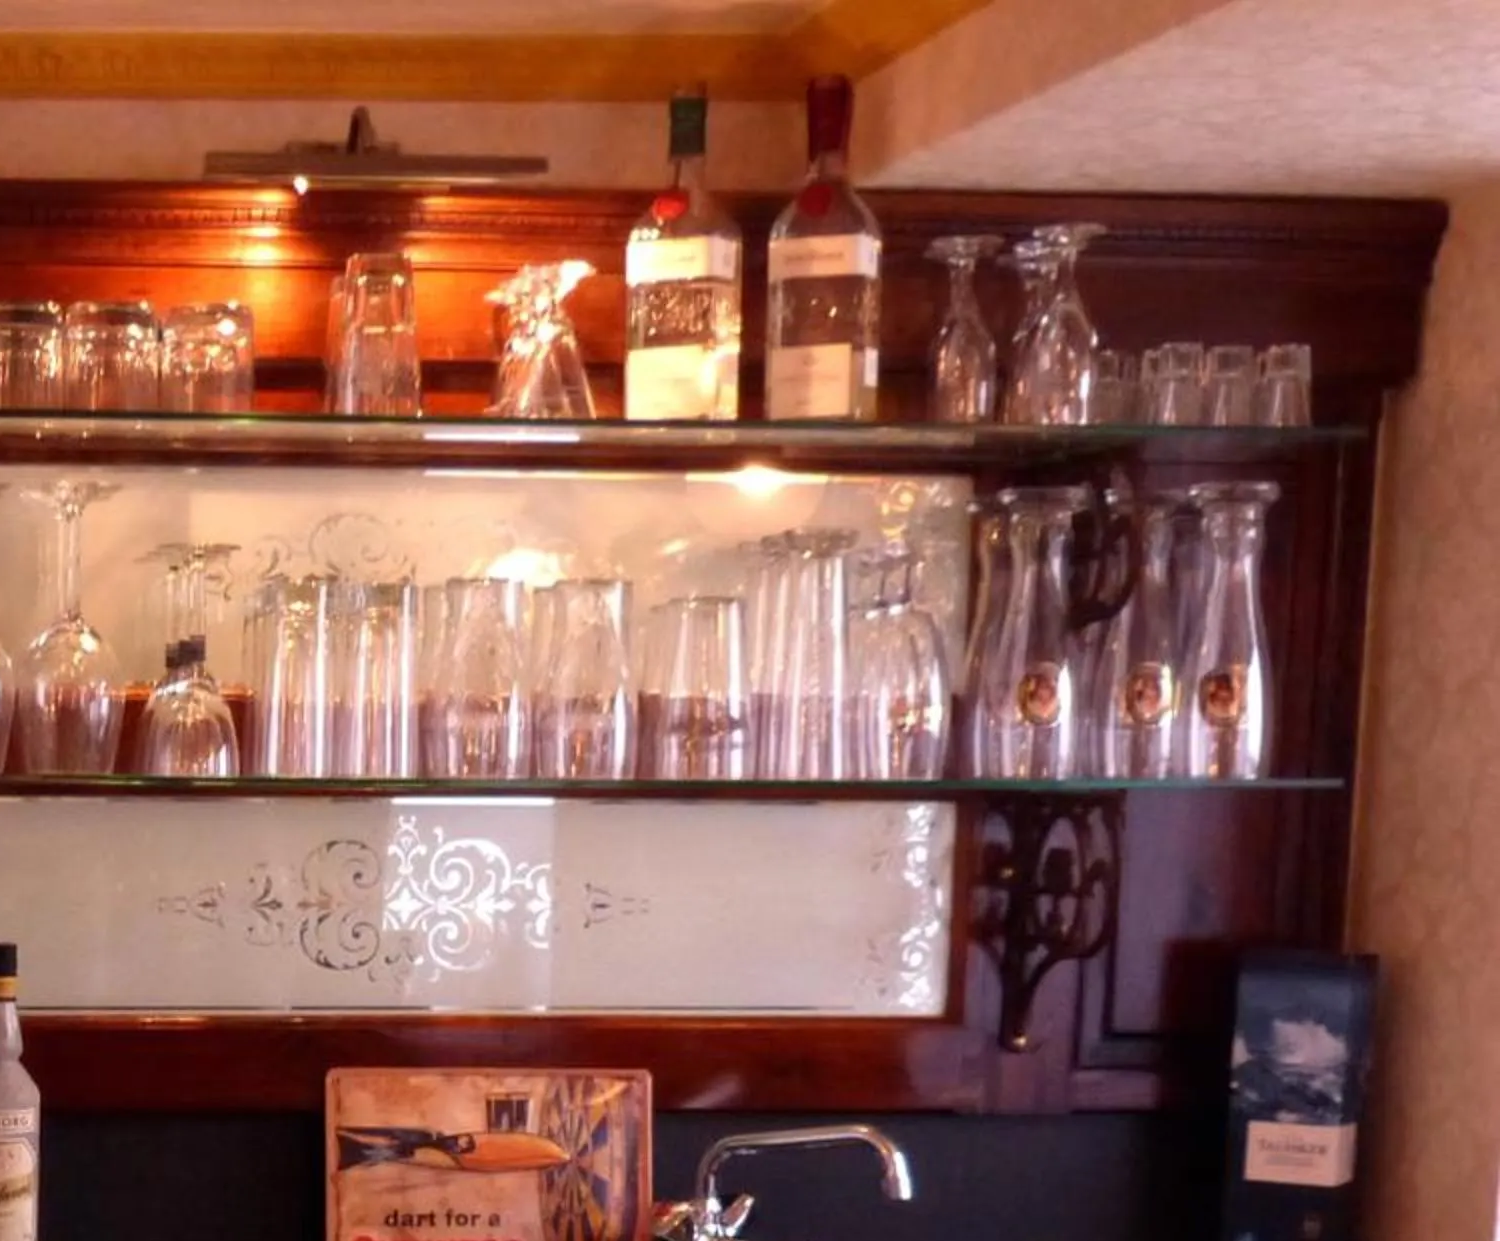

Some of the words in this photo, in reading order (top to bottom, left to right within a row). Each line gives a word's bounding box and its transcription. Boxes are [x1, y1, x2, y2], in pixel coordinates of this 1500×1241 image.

[384, 1208, 436, 1228] dart
[445, 1207, 481, 1228] for
[488, 1213, 501, 1228] a
